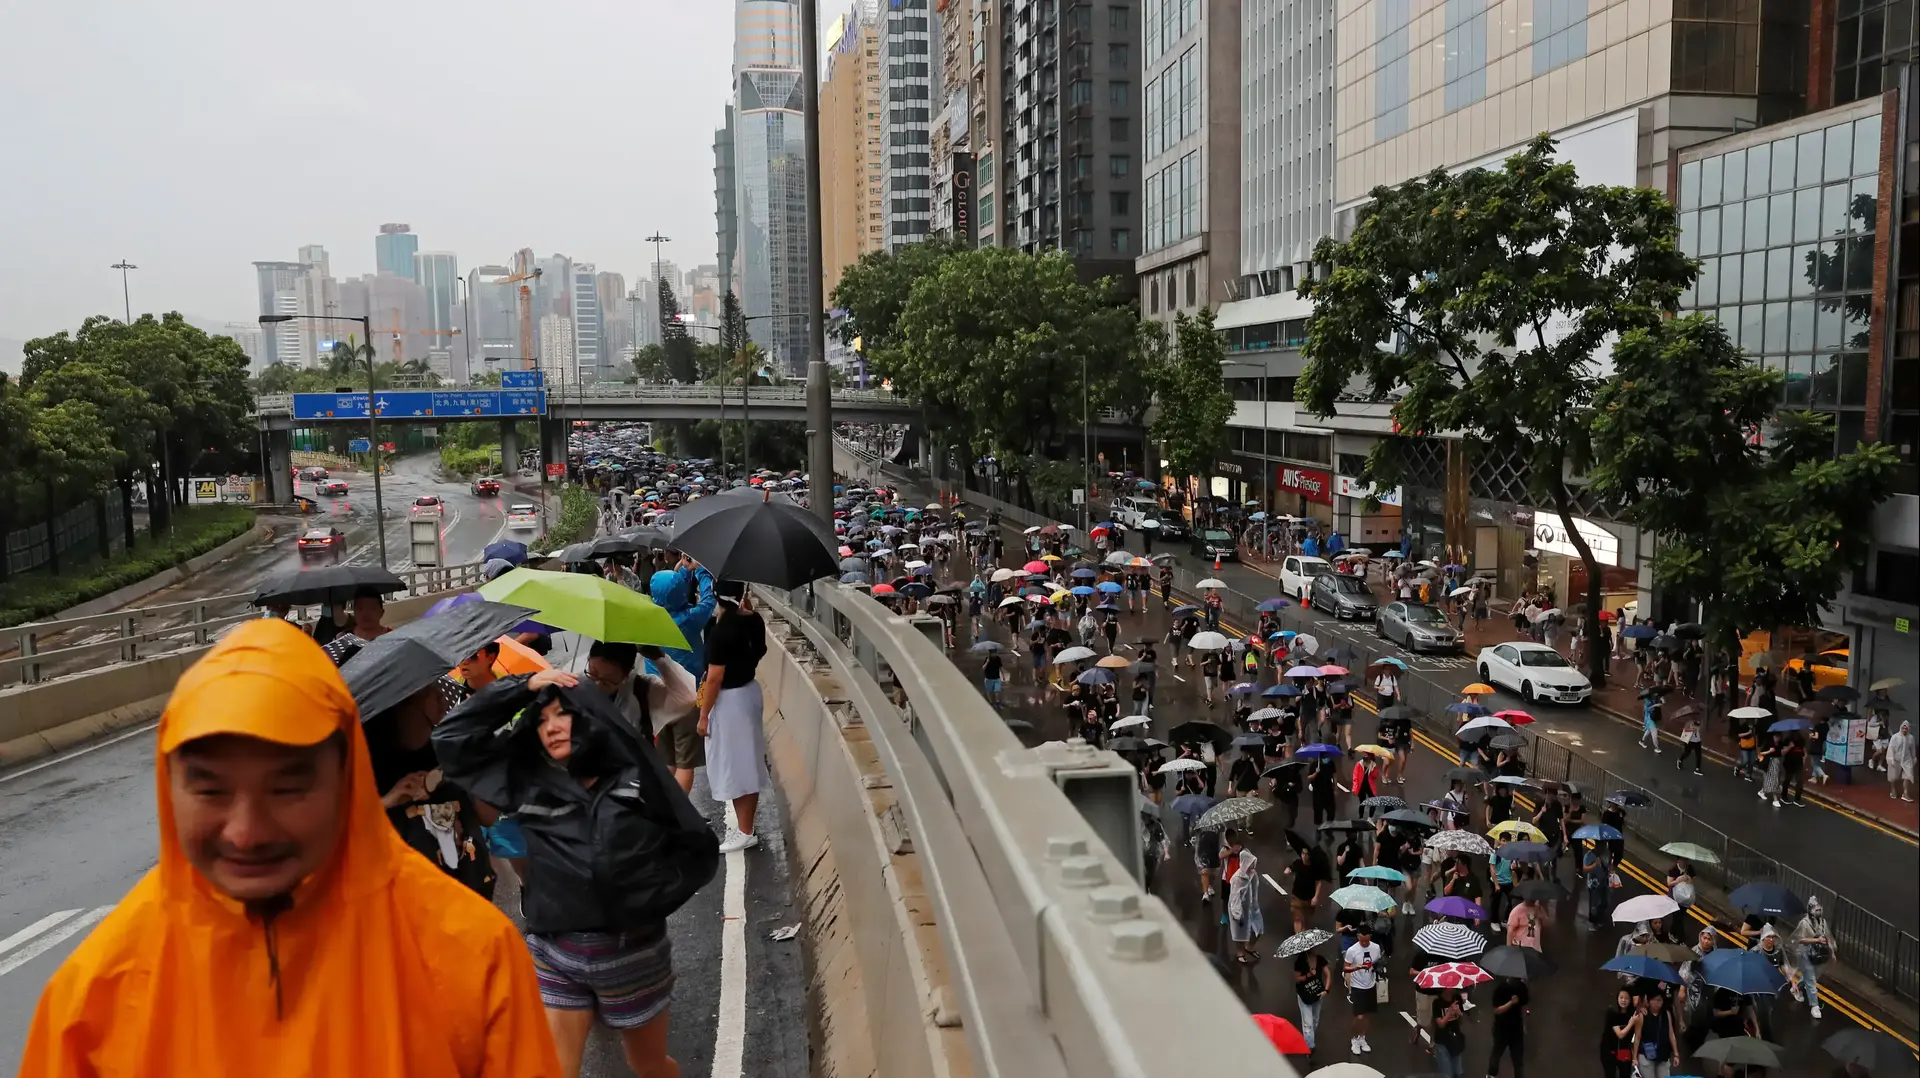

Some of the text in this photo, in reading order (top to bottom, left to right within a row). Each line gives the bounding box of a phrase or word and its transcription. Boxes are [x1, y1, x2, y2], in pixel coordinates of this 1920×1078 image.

[200, 481, 215, 493] AA
[1282, 469, 1299, 488] AVIS
[1300, 475, 1322, 496] Prestige
